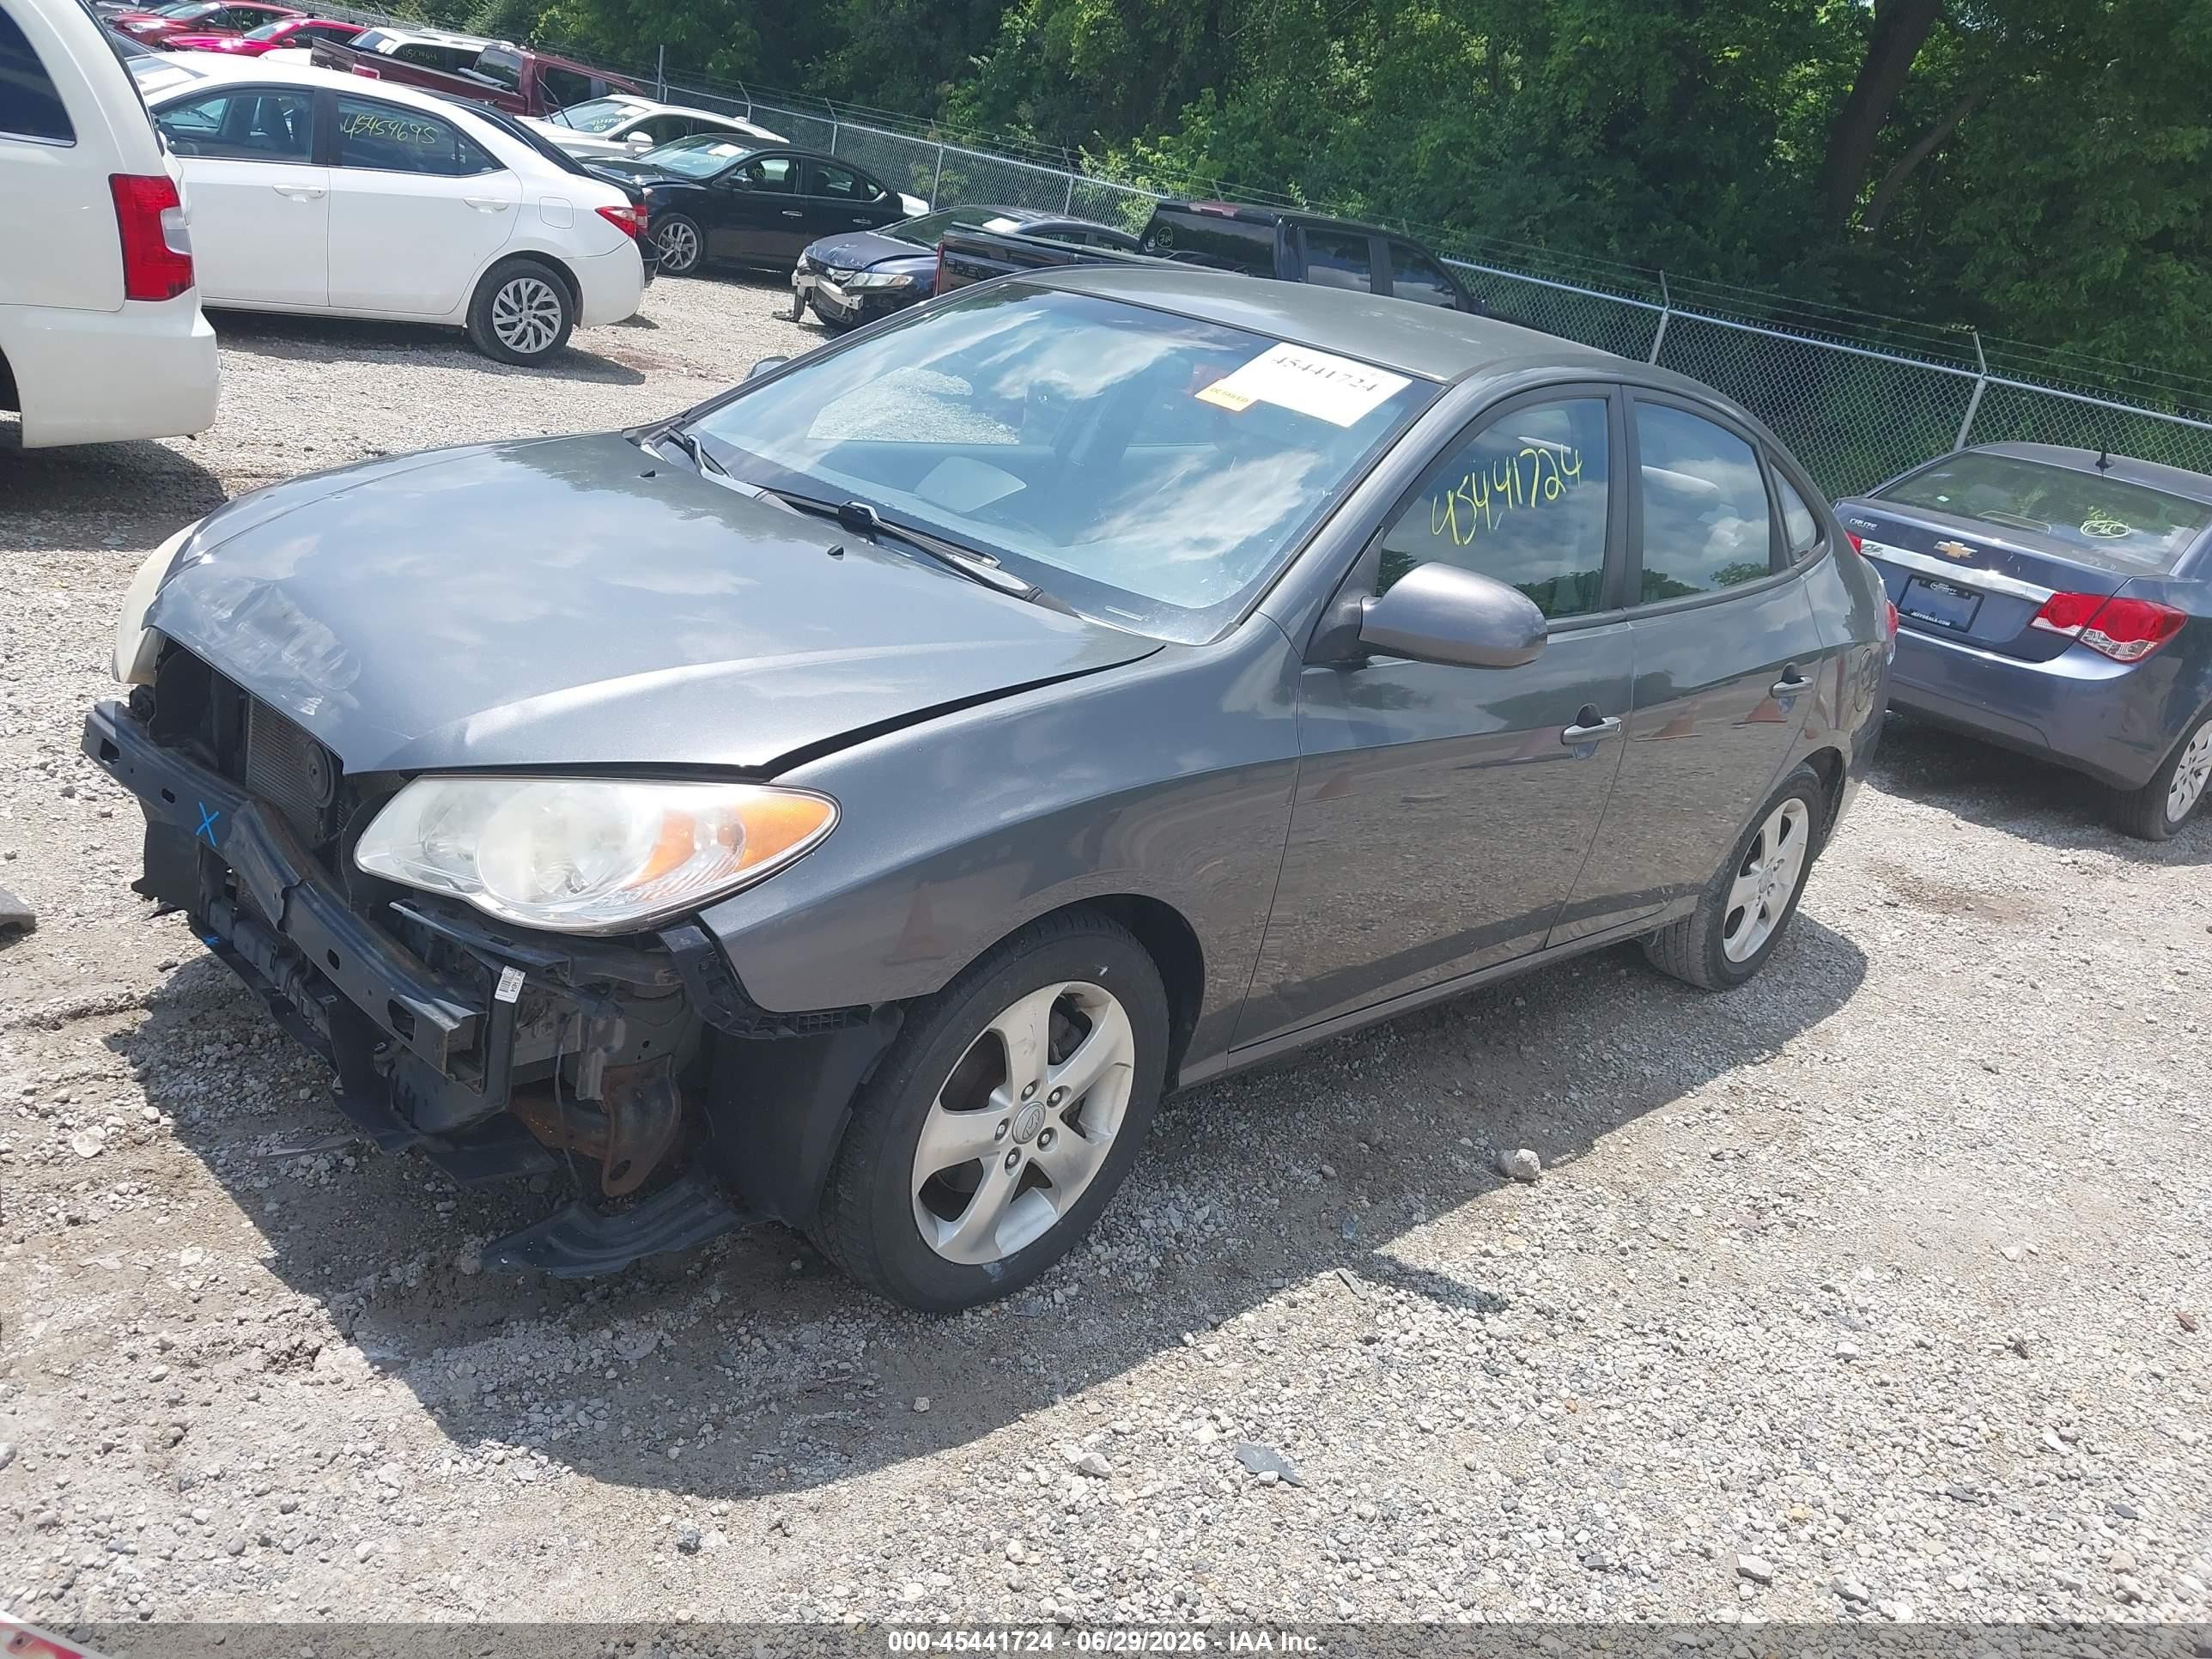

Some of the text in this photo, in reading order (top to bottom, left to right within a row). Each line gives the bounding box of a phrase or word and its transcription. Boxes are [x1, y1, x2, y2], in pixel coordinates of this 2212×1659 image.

[1273, 357, 1378, 392] 45441724
[1431, 444, 1583, 545] 45441724
[1849, 518, 1878, 531] CRUZE
